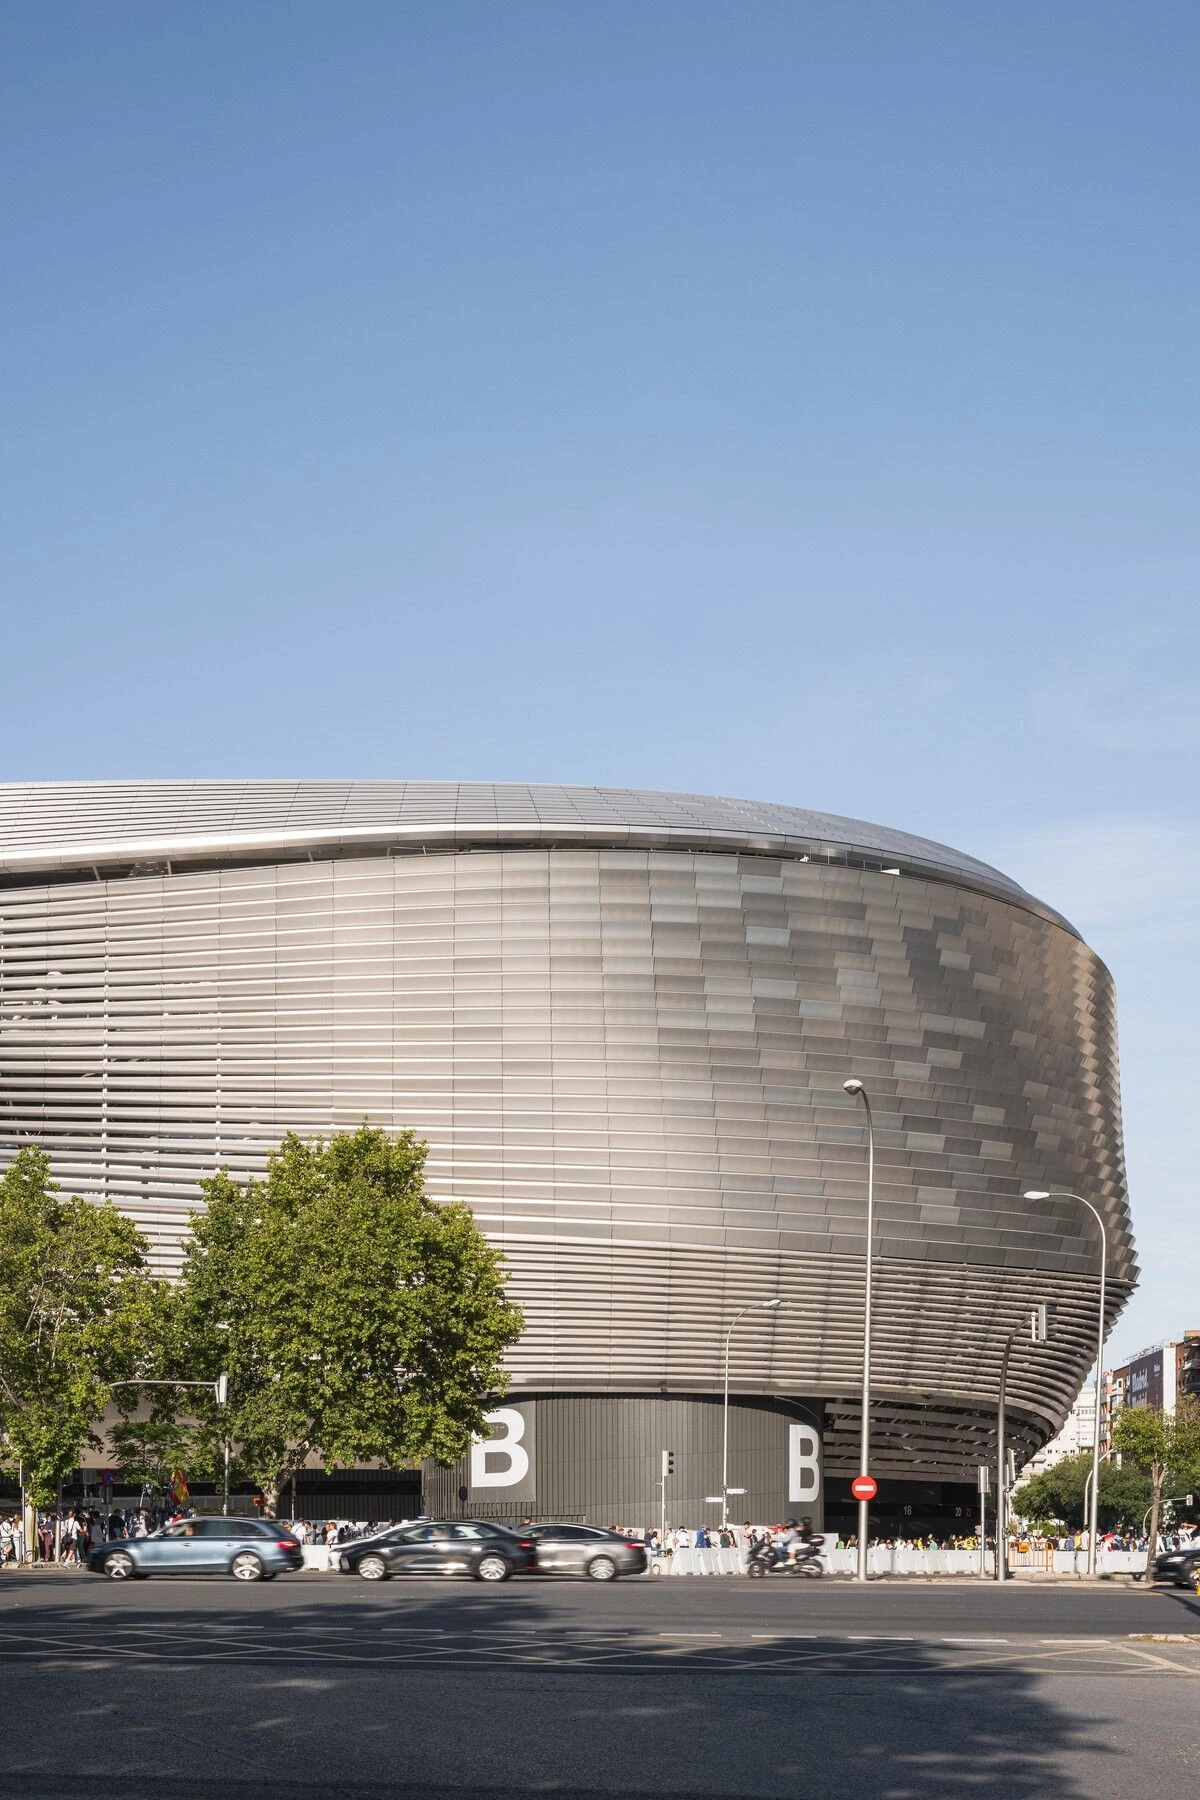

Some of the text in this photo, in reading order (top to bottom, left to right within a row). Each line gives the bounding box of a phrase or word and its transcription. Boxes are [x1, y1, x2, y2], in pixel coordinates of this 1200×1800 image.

[471, 1408, 529, 1488] B
[789, 1424, 820, 1502] B
[904, 1505, 912, 1516] 18
[955, 1507, 962, 1517] 20
